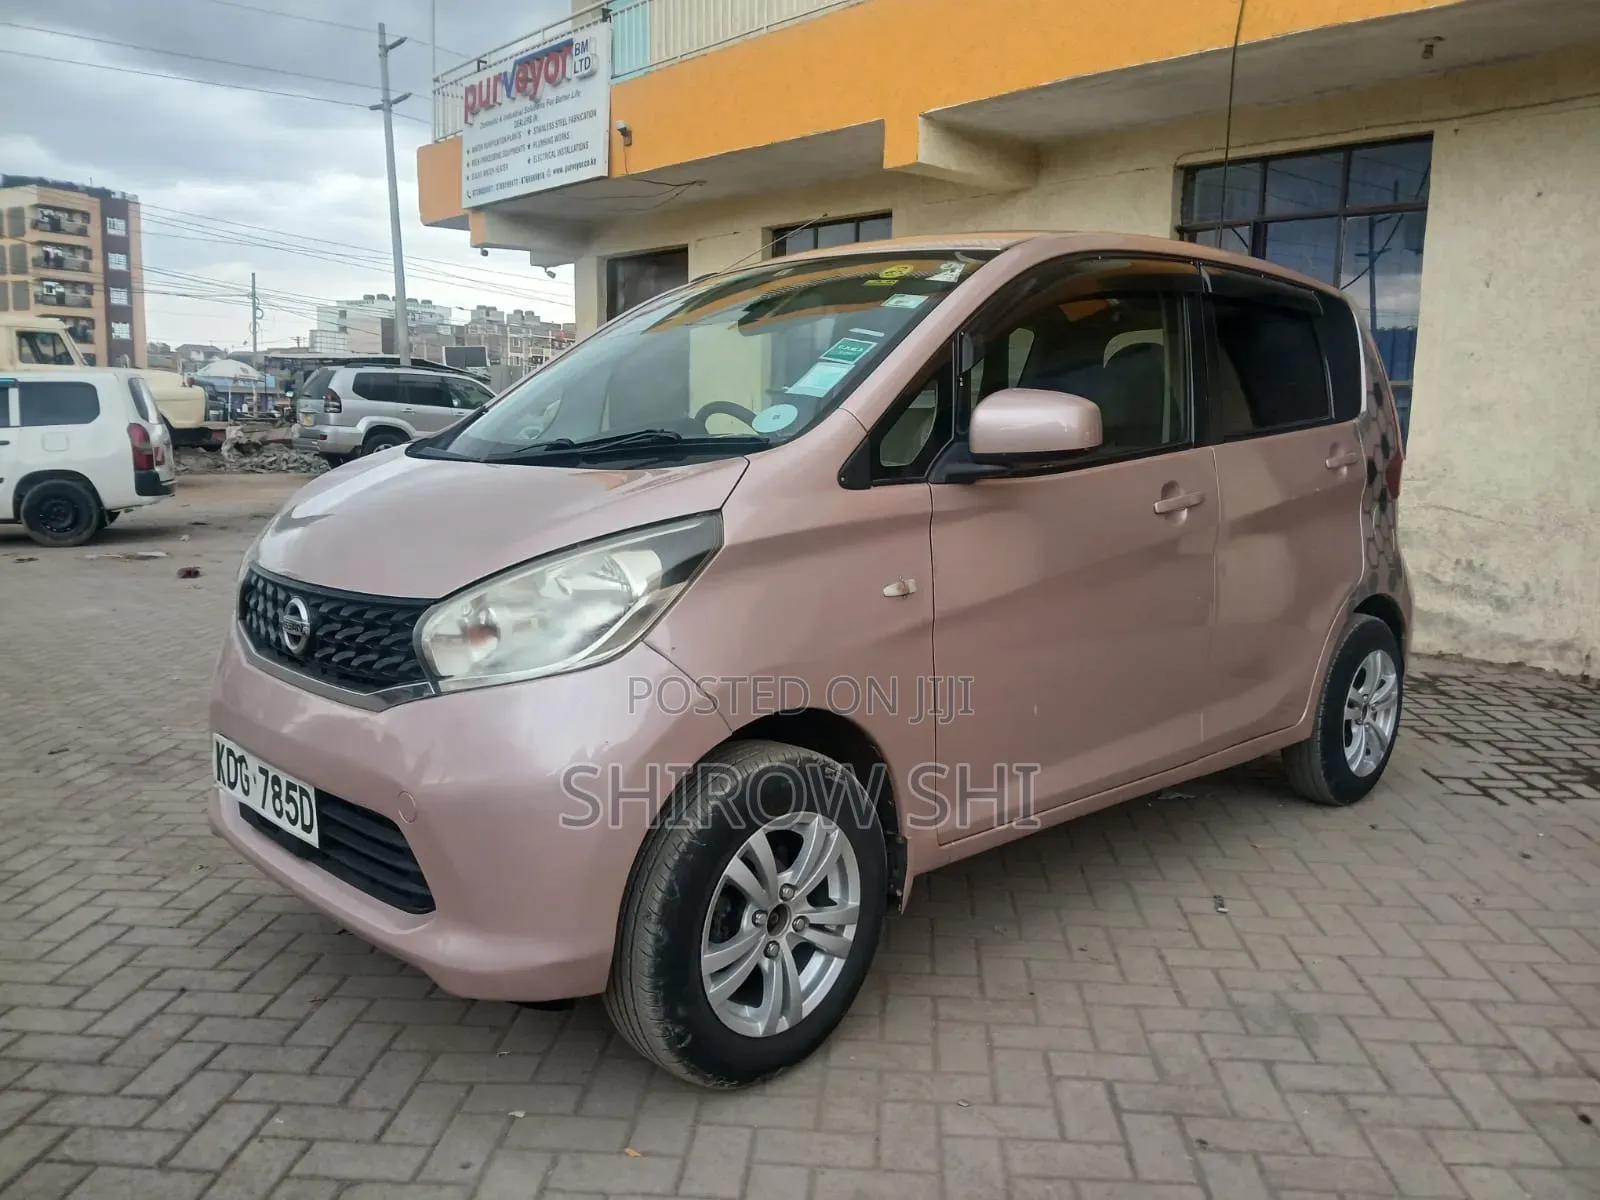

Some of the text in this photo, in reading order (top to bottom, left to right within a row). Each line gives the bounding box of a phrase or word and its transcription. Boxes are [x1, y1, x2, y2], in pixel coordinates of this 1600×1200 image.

[574, 39, 589, 57] BM
[573, 57, 591, 75] LTD
[568, 109, 597, 126] FABRICATION
[554, 131, 570, 144] WORKS
[216, 741, 314, 835] KDG 785D
